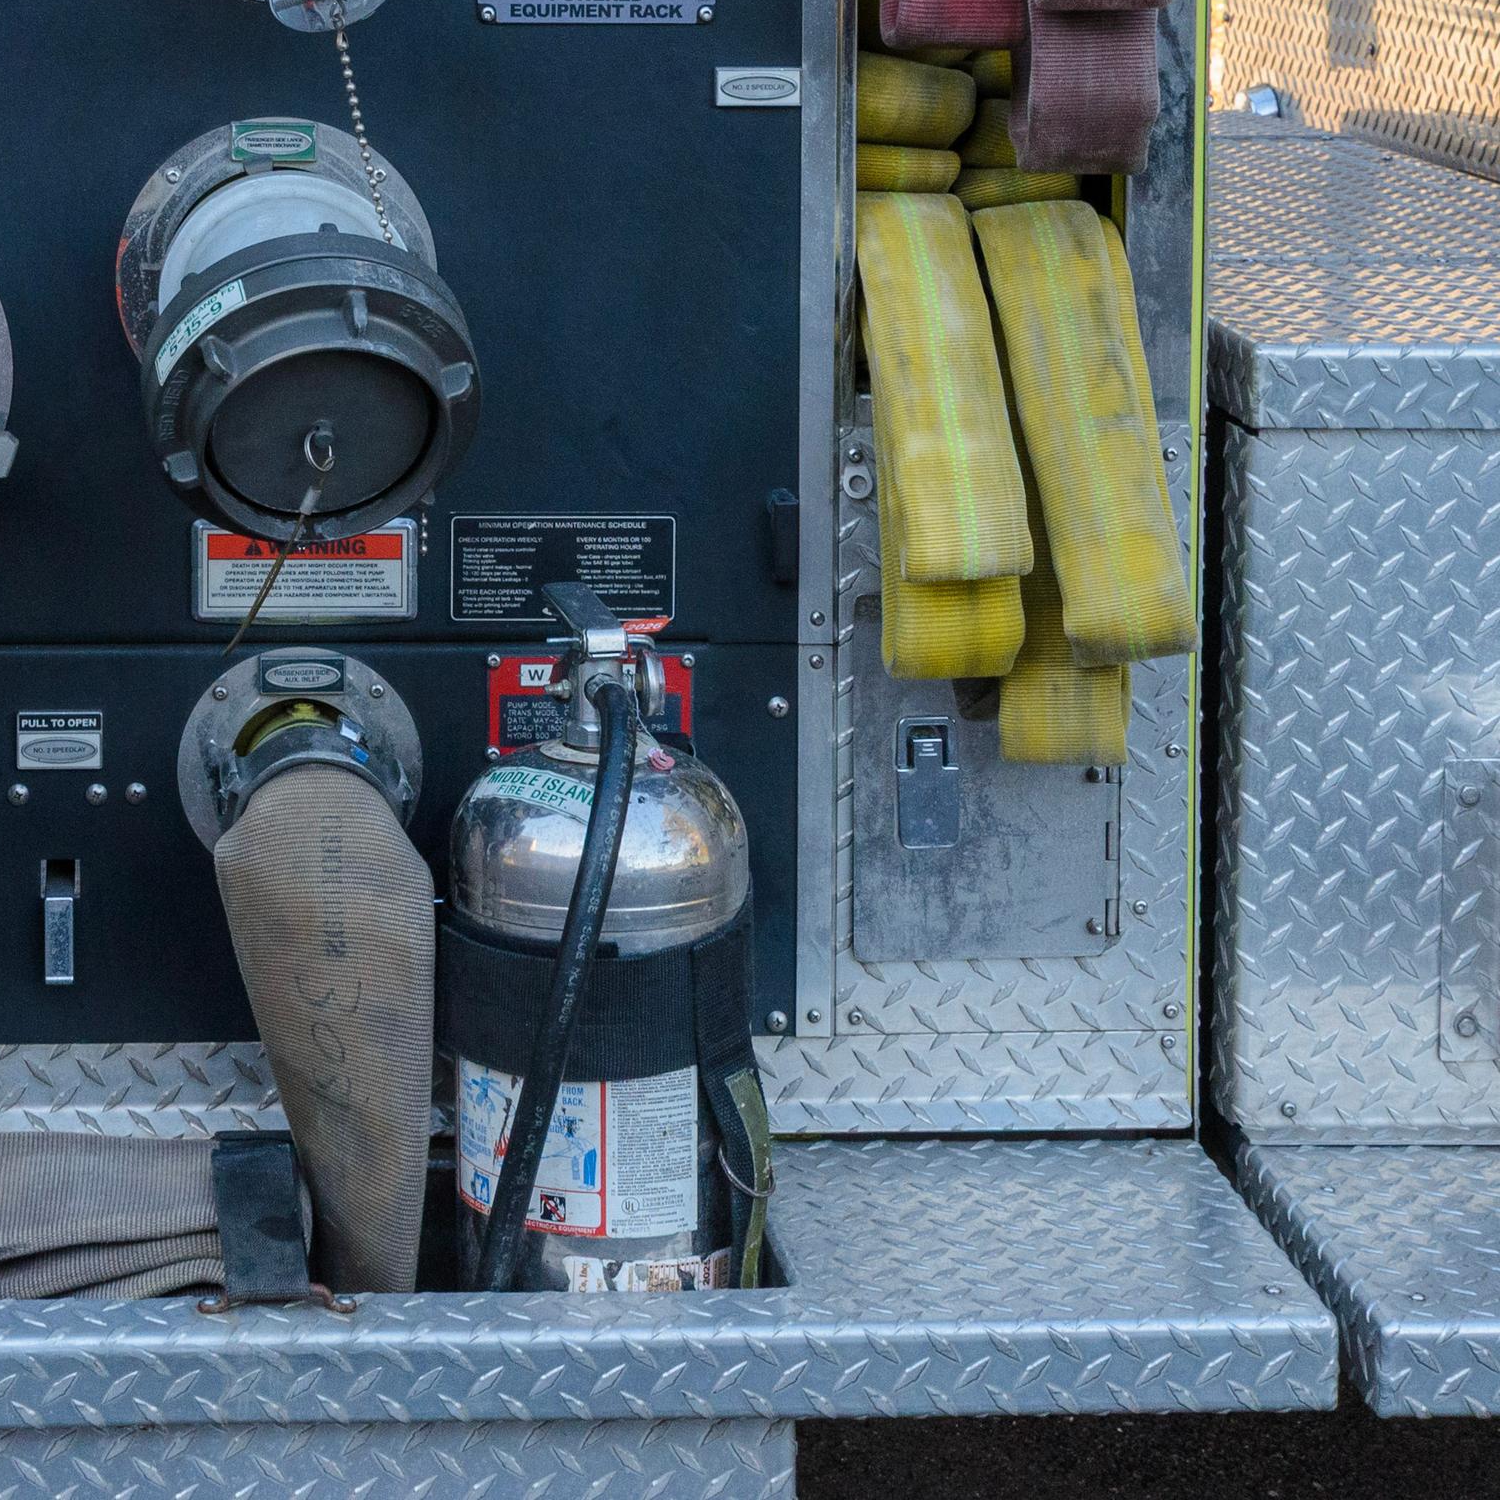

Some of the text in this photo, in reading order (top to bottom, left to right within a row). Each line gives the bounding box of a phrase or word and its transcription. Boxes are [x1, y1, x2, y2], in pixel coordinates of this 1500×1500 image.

[510, 3, 683, 19] EQUIPMENT RACK
[158, 285, 235, 360] MIDDLE ISLAND FD
[169, 301, 222, 357] 5-15-9
[267, 538, 367, 555] WNING
[507, 701, 556, 709] PUMP MODEL
[508, 709, 532, 717] TRANS
[535, 709, 560, 717] MODEL
[21, 718, 97, 728] PULL TO OPEN
[507, 716, 526, 724] DATE
[507, 724, 543, 732] CAPACITY
[507, 732, 533, 740] HYDRO
[489, 771, 542, 786] MIDDLE
[497, 784, 567, 810] FIRE DEPT.
[561, 1086, 584, 1096] FROM
[562, 1097, 586, 1107] BACK.
[558, 1225, 597, 1235] EQUIPMENT
